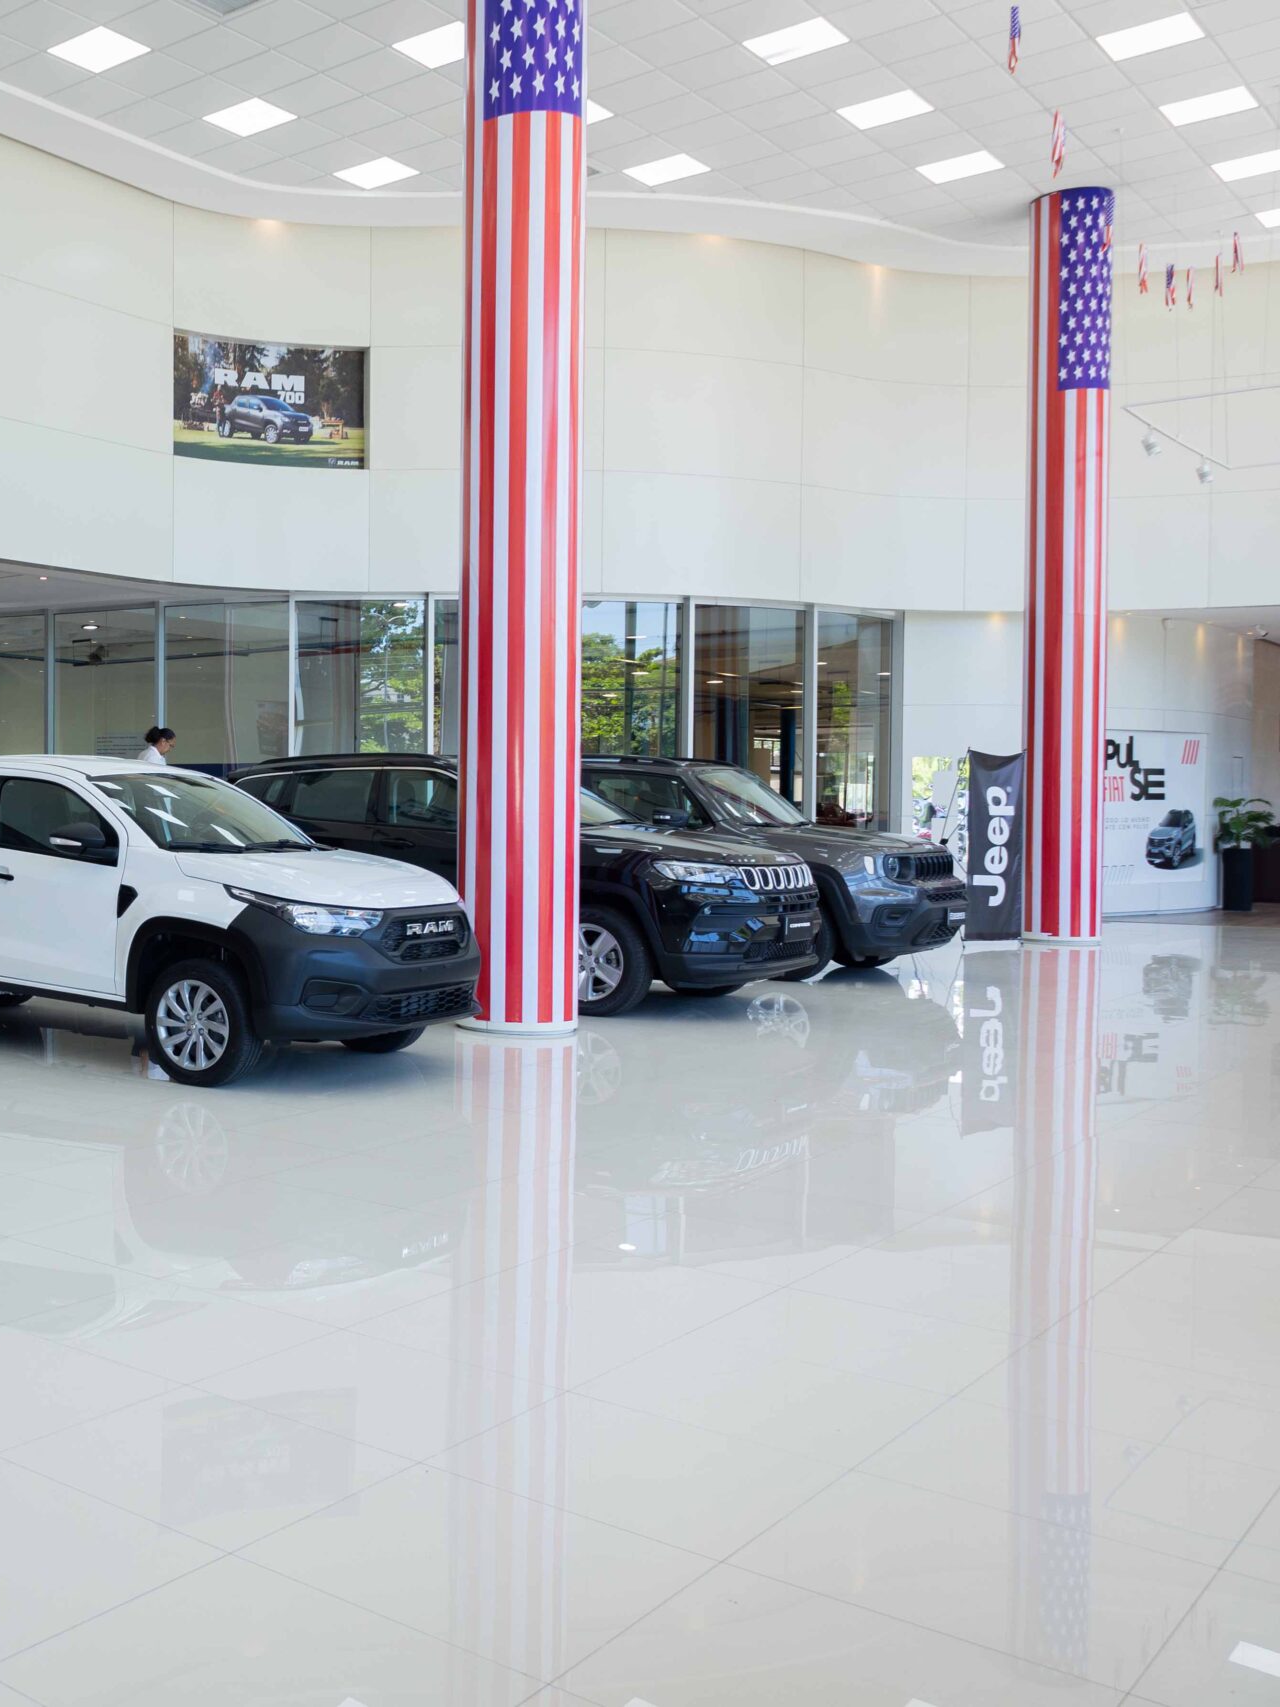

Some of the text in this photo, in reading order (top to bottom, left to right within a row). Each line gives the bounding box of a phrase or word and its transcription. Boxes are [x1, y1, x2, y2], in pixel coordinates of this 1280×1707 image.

[214, 368, 305, 392] RAM
[277, 391, 305, 405] 700
[972, 786, 1015, 907] Jeep
[406, 920, 454, 936] RAM
